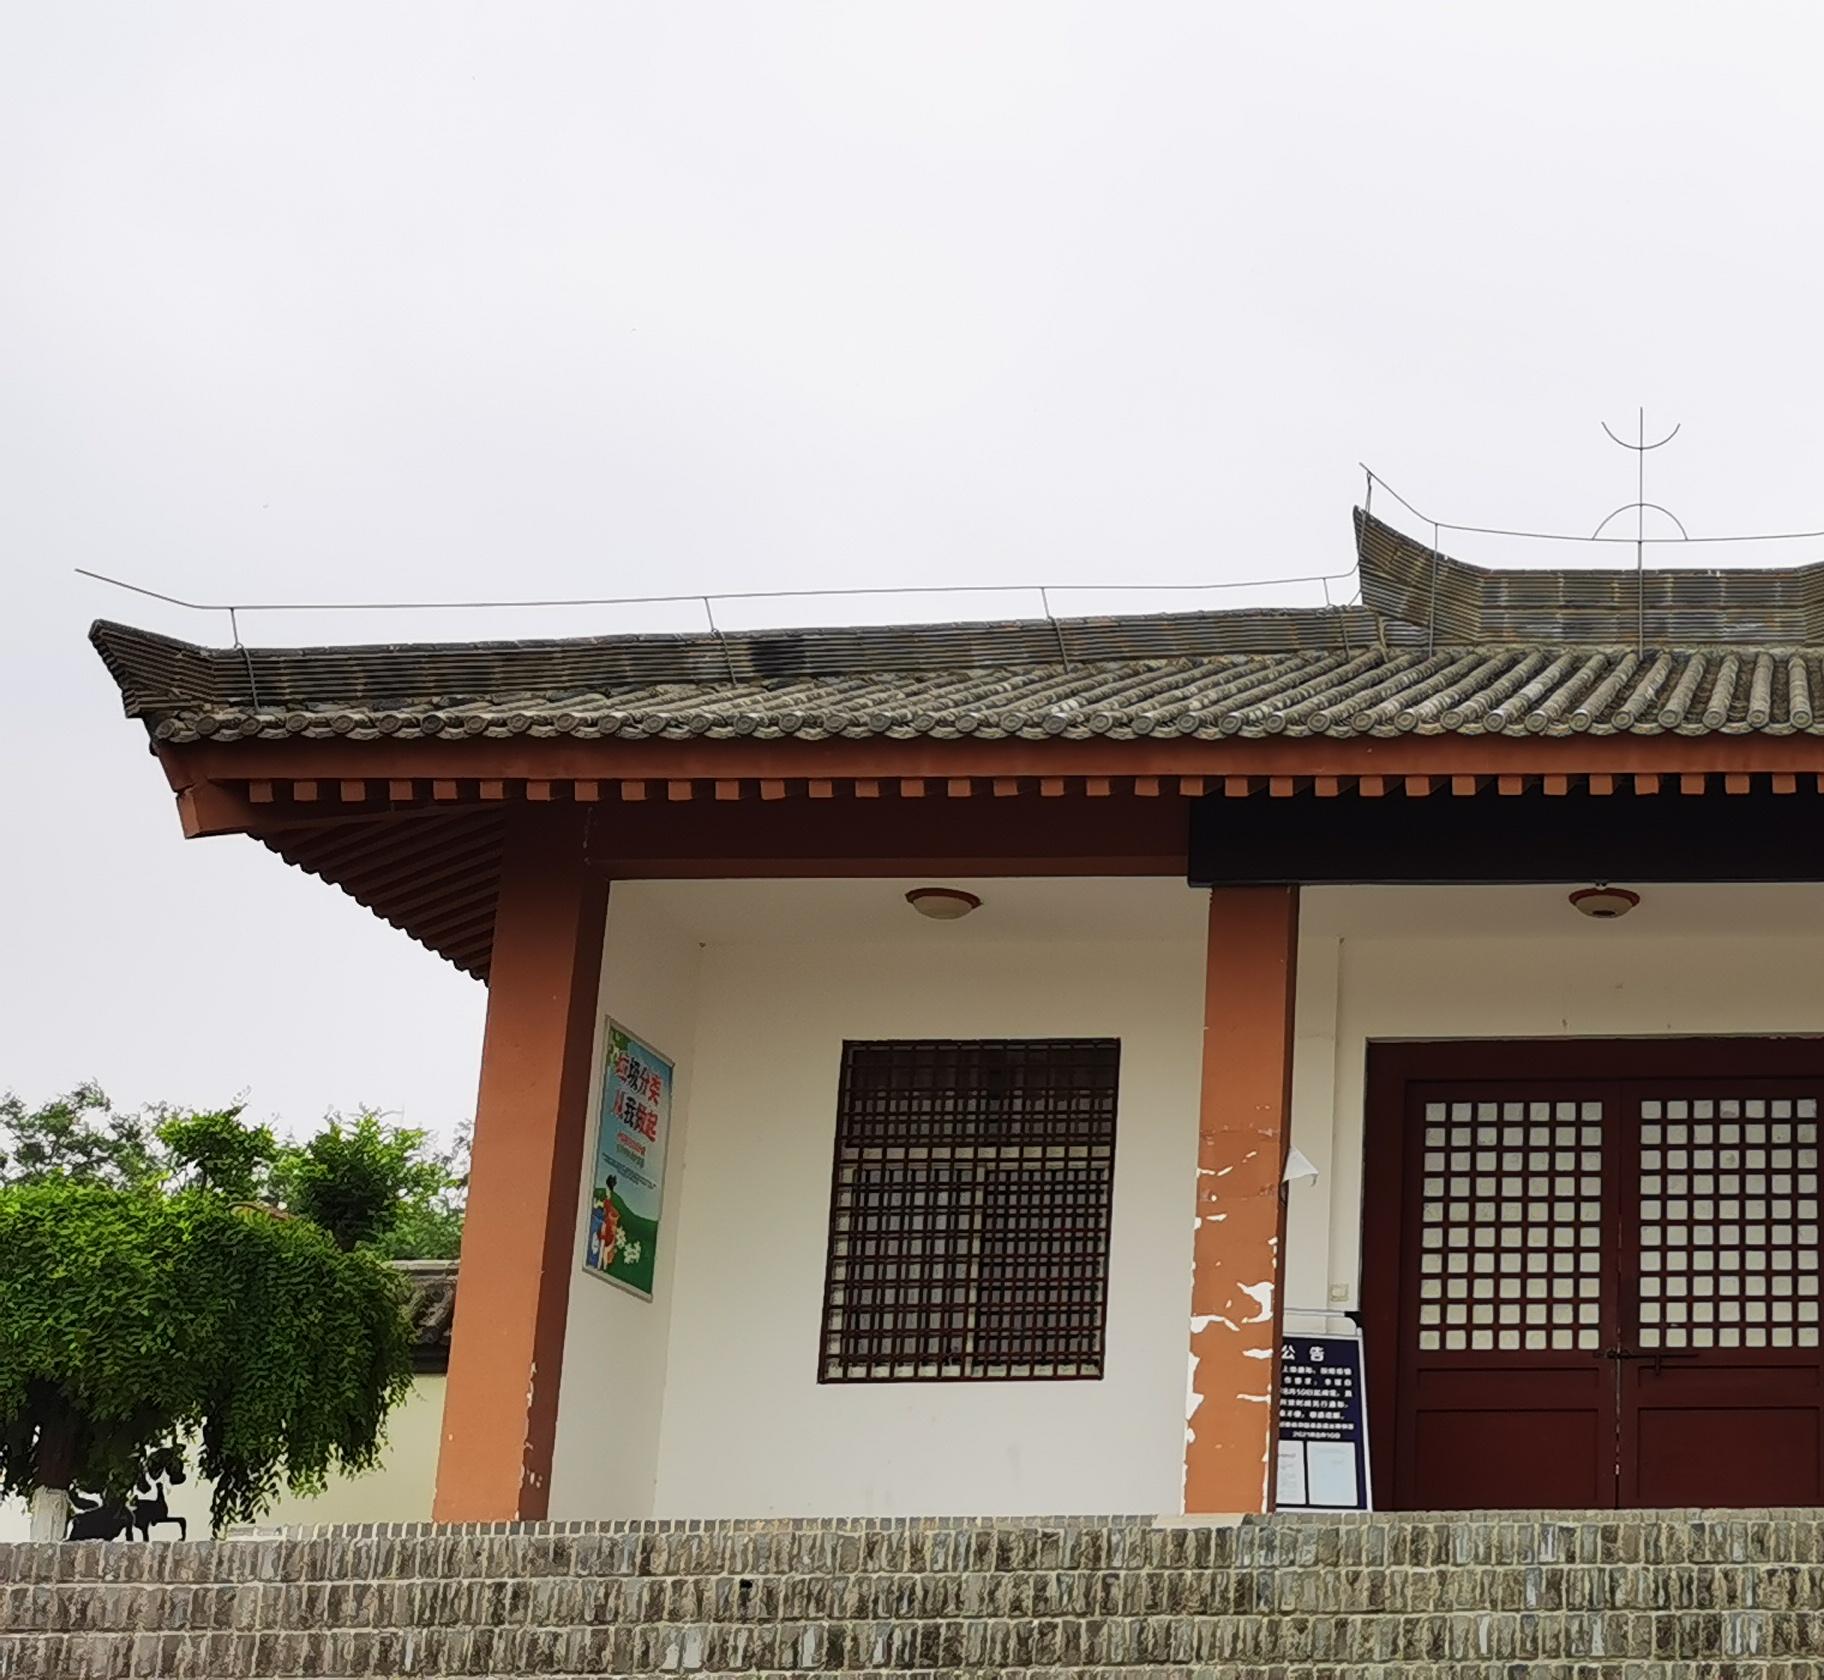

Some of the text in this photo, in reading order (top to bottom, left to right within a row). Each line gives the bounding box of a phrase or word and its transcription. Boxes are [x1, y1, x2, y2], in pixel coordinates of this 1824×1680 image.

[614, 1053, 662, 1106] 垃圾分类
[613, 1089, 659, 1142] 从我做起
[1281, 1344, 1325, 1362] 公告
